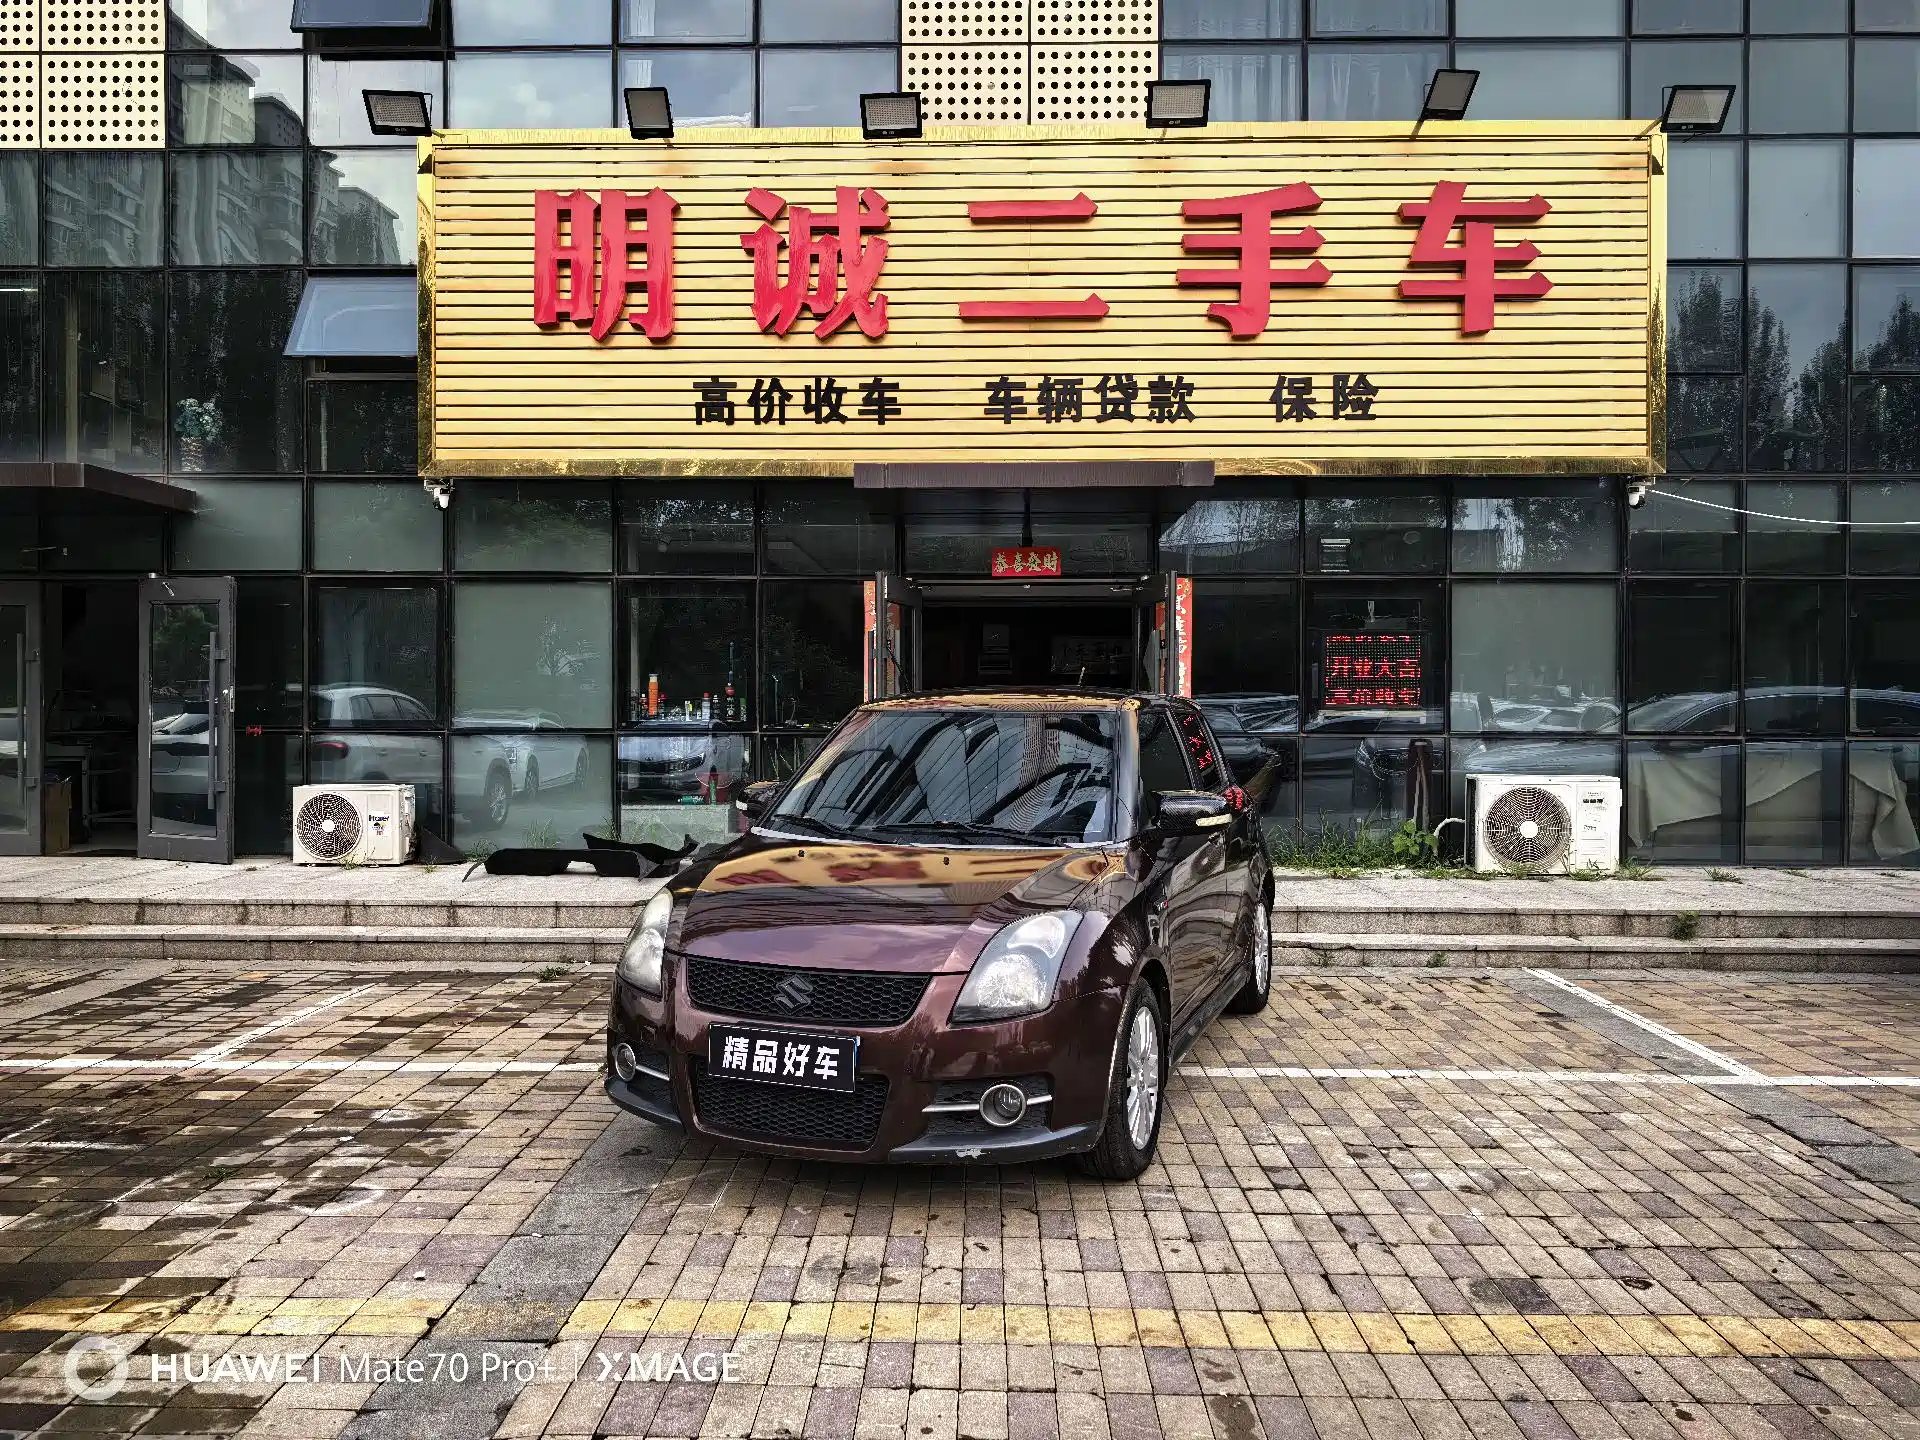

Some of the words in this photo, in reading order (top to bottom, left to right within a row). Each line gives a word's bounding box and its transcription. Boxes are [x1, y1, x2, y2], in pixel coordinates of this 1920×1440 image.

[533, 181, 1554, 345] 明诚二手车
[693, 376, 902, 425] 高价收车
[983, 375, 1197, 424] 车辆贷款
[1269, 373, 1381, 422] 保险
[1331, 656, 1418, 678] 开业大吉
[722, 1035, 841, 1080] 精品好车
